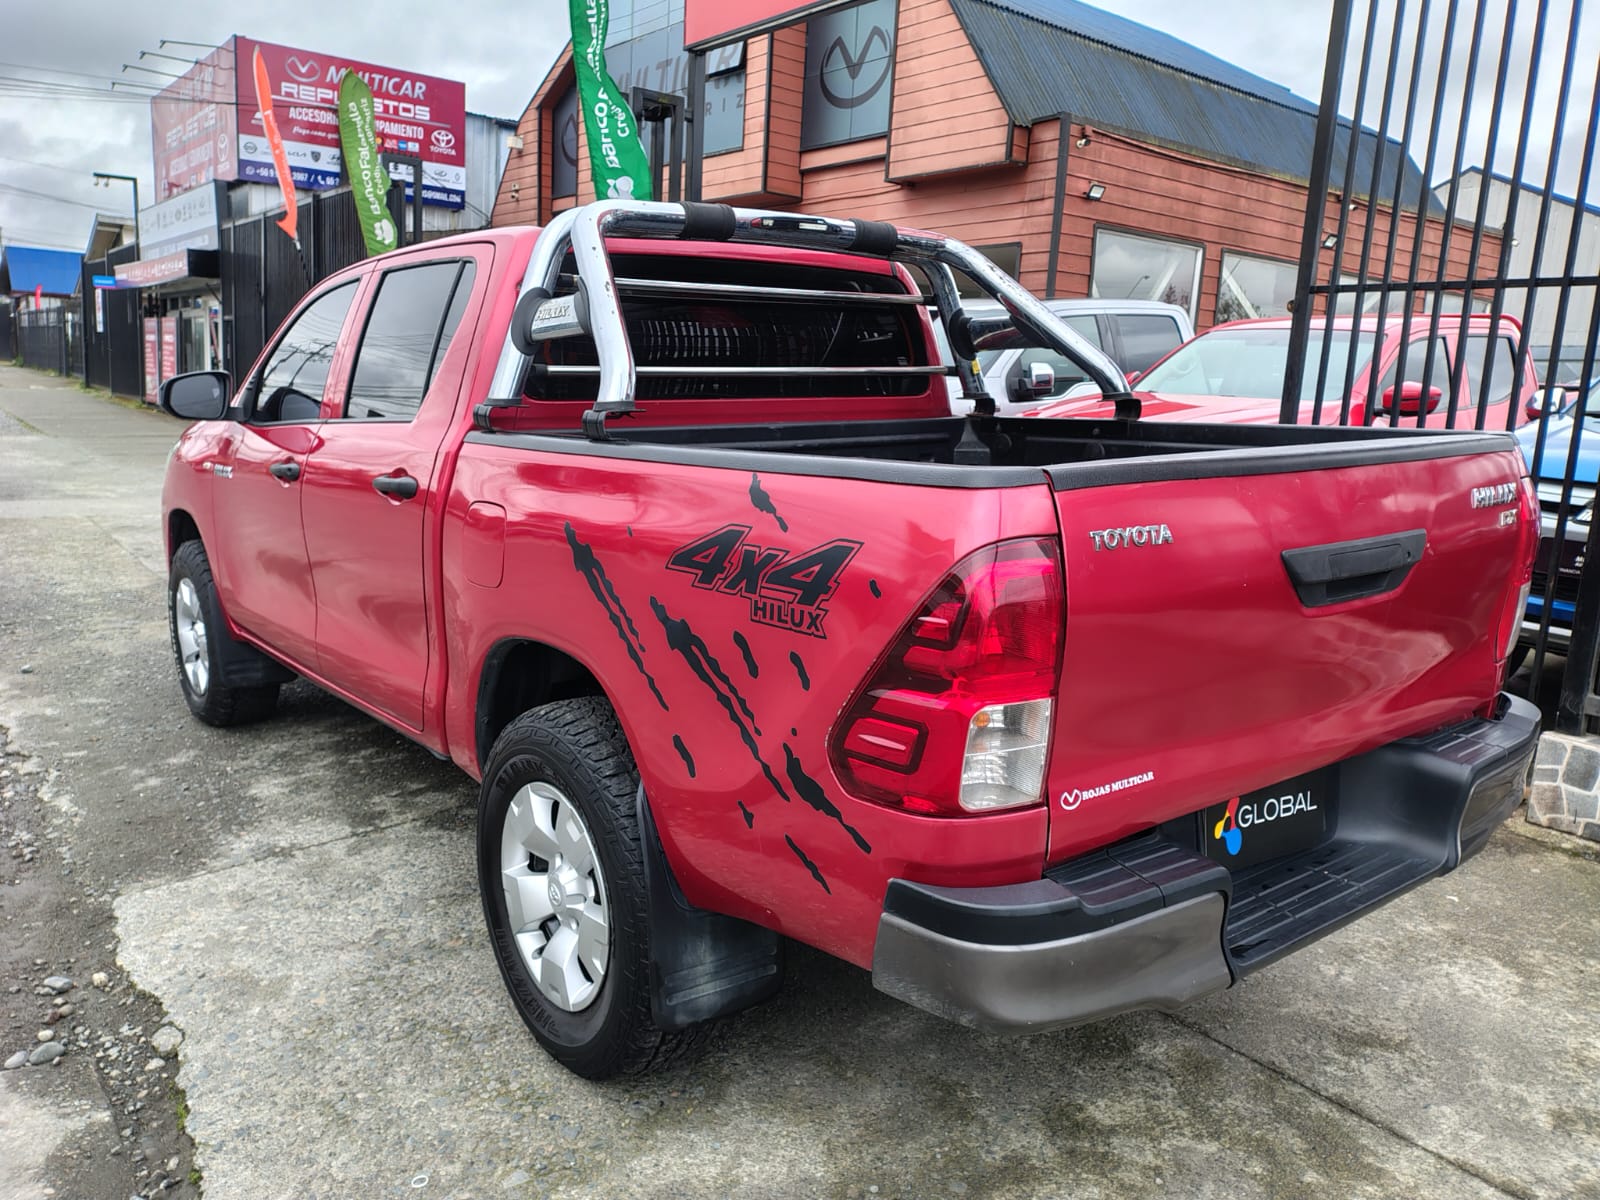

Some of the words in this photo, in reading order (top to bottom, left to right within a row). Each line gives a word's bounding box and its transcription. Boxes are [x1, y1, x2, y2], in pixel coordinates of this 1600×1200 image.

[281, 80, 431, 120] REPSTOS
[1471, 482, 1517, 509] HILUX
[1089, 524, 1174, 551] TOYOTA
[752, 598, 826, 636] HILUX
[1082, 785, 1111, 801] ROJAS
[1111, 771, 1155, 794] MULTICAR
[1238, 791, 1318, 828] GLOBAL
